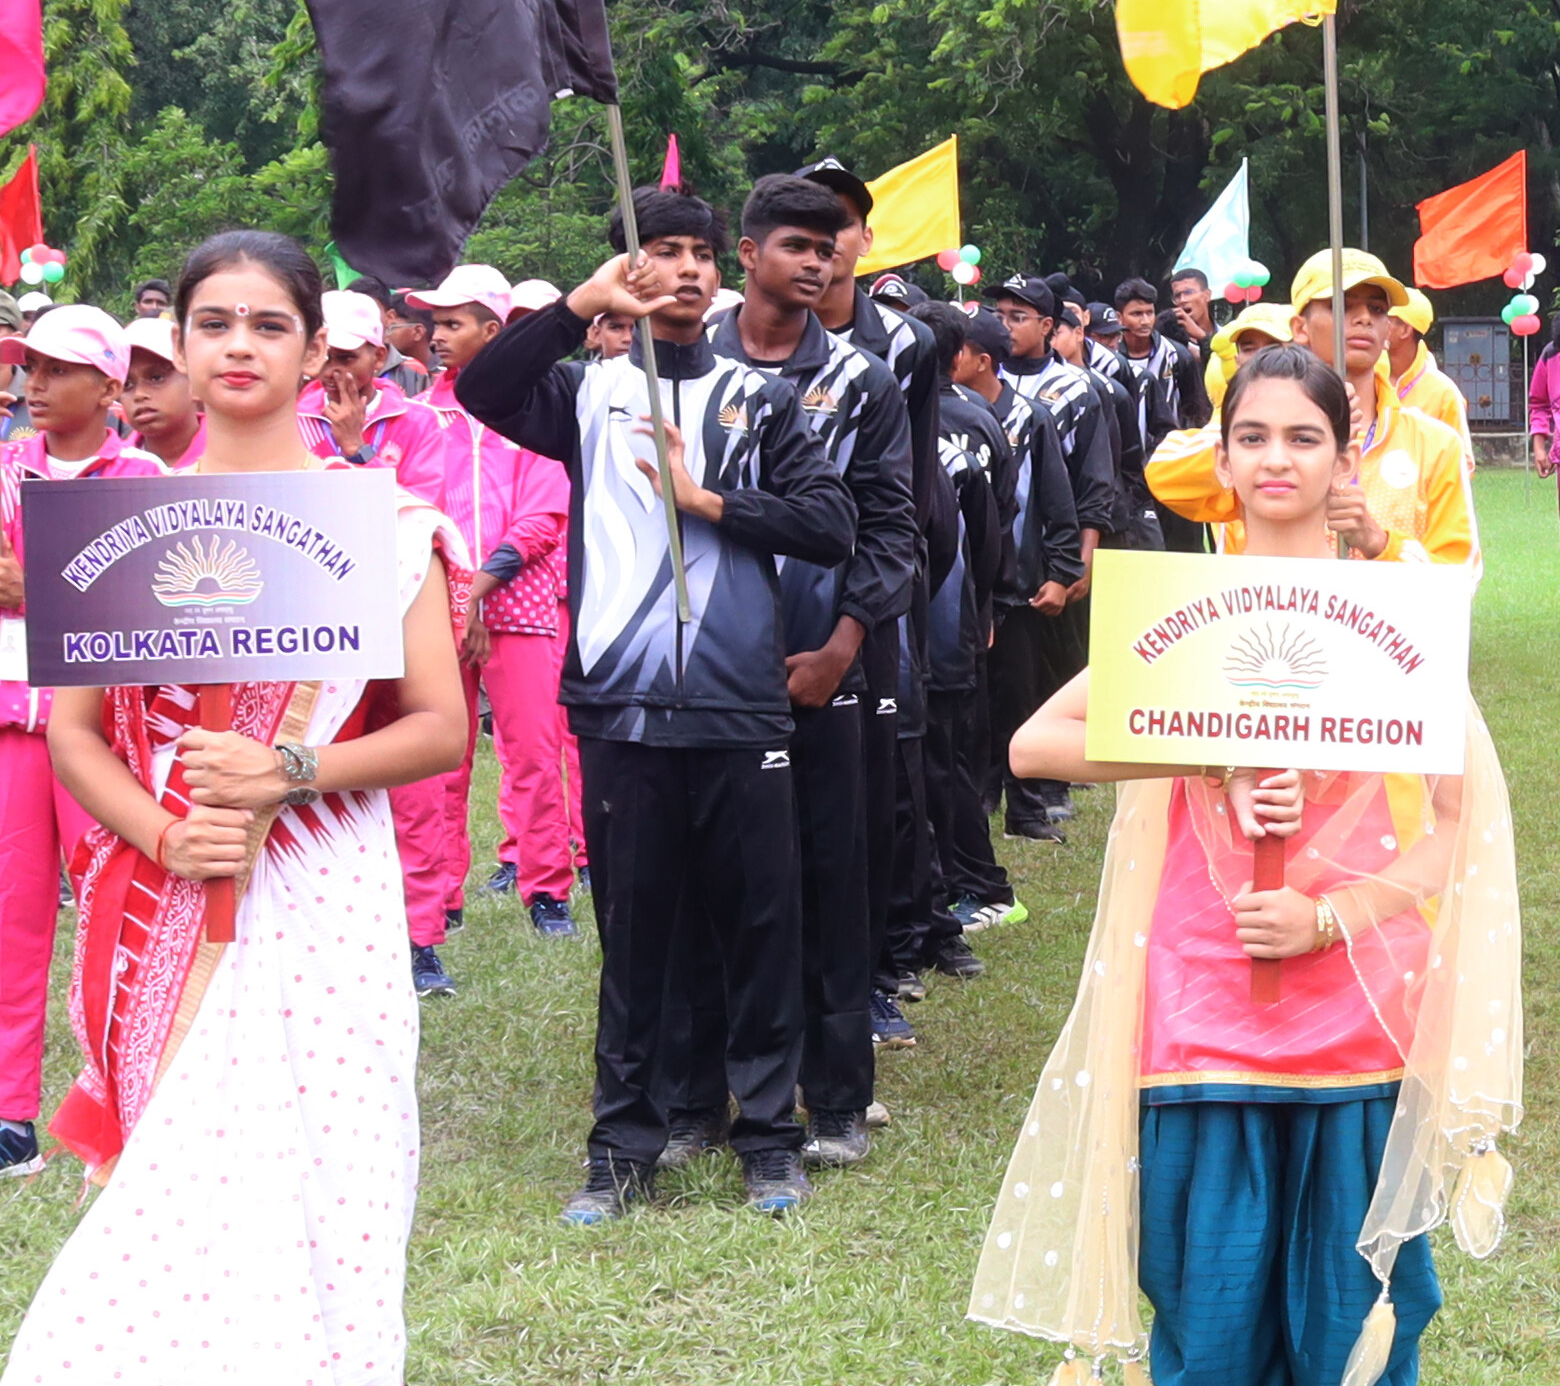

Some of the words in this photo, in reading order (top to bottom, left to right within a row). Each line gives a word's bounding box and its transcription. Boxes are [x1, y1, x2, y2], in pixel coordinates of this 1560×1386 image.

[61, 515, 151, 593] KENDRIYA
[145, 499, 247, 537] VIDYALAYA
[251, 504, 357, 582] SANGATHAN
[64, 627, 222, 662] KOLKATA
[232, 625, 362, 658] REGION
[1132, 597, 1221, 665] KENDRIYA
[1221, 584, 1320, 616] VIDYALAYA
[1323, 593, 1427, 676] SANGATHAN
[1127, 708, 1311, 742] CHANDIGARH
[1319, 716, 1424, 746] REGION
